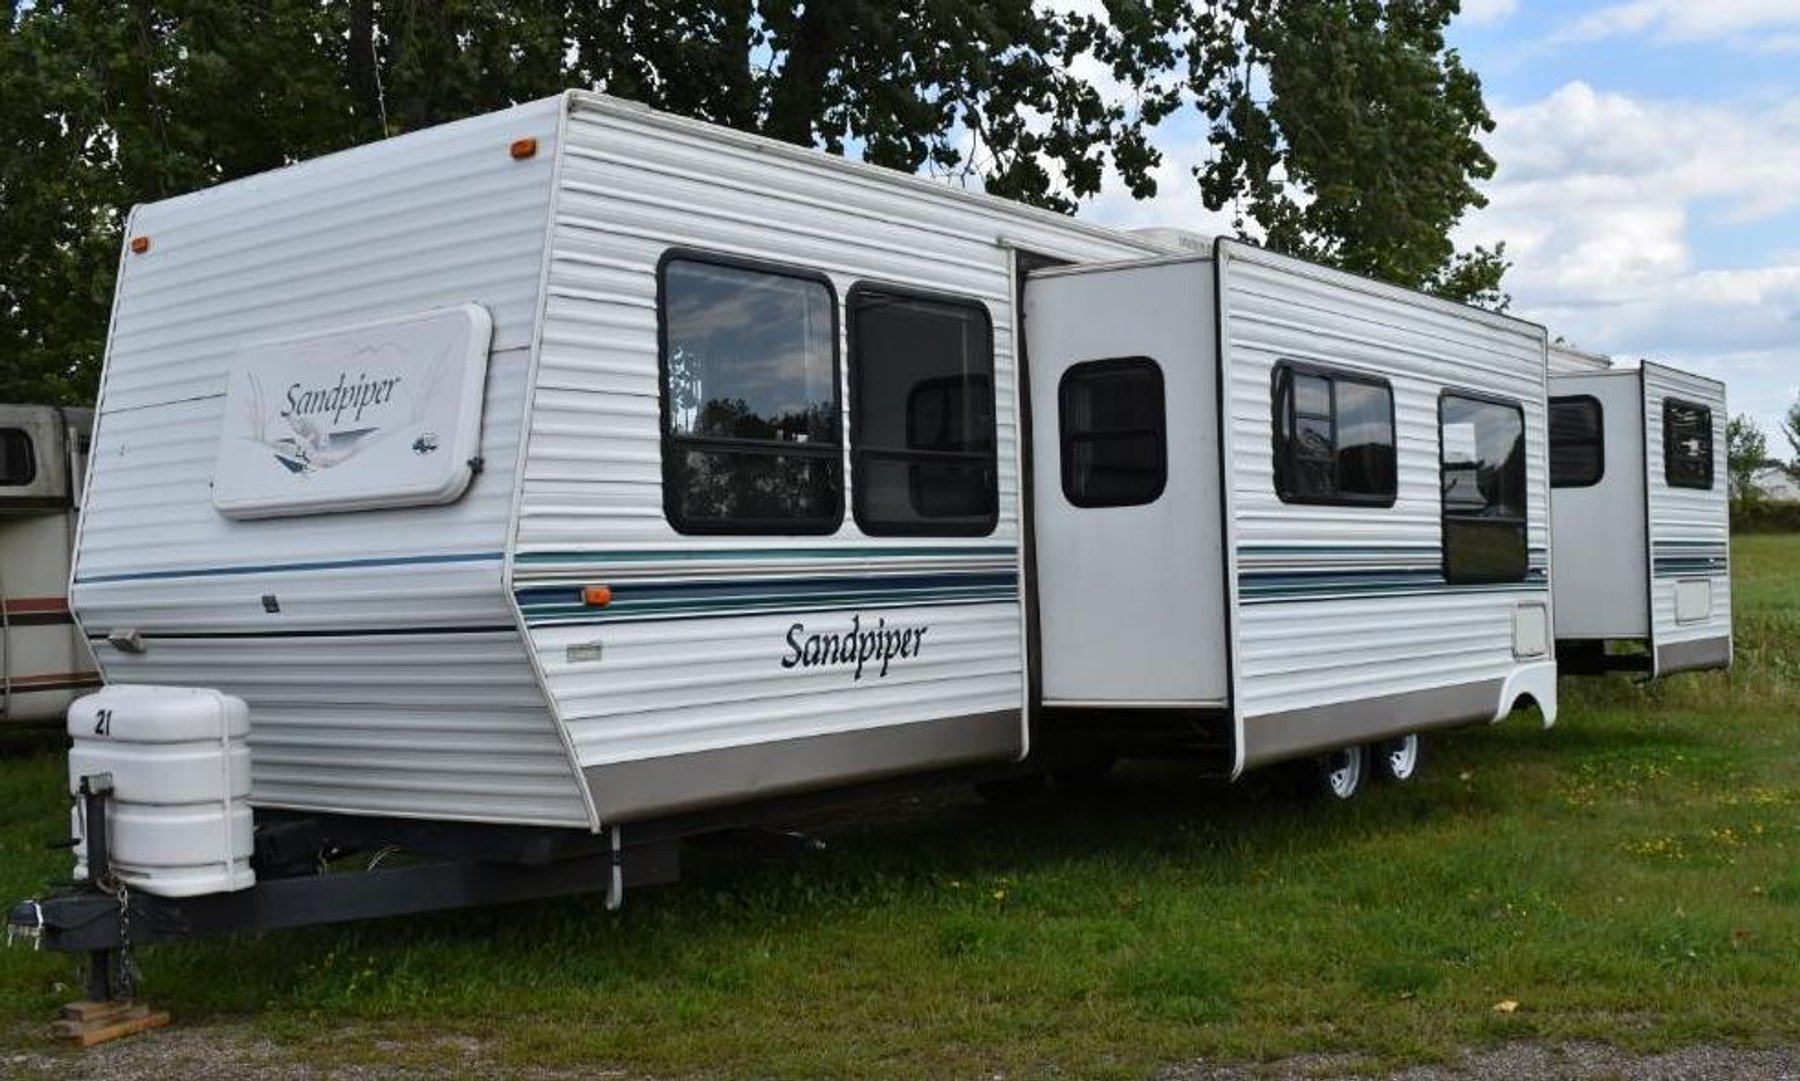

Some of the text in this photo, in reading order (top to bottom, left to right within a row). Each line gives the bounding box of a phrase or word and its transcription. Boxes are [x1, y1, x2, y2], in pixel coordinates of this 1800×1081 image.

[281, 372, 401, 425] Sandpiper
[781, 614, 928, 681] Sandpiper
[95, 709, 112, 736] 21
